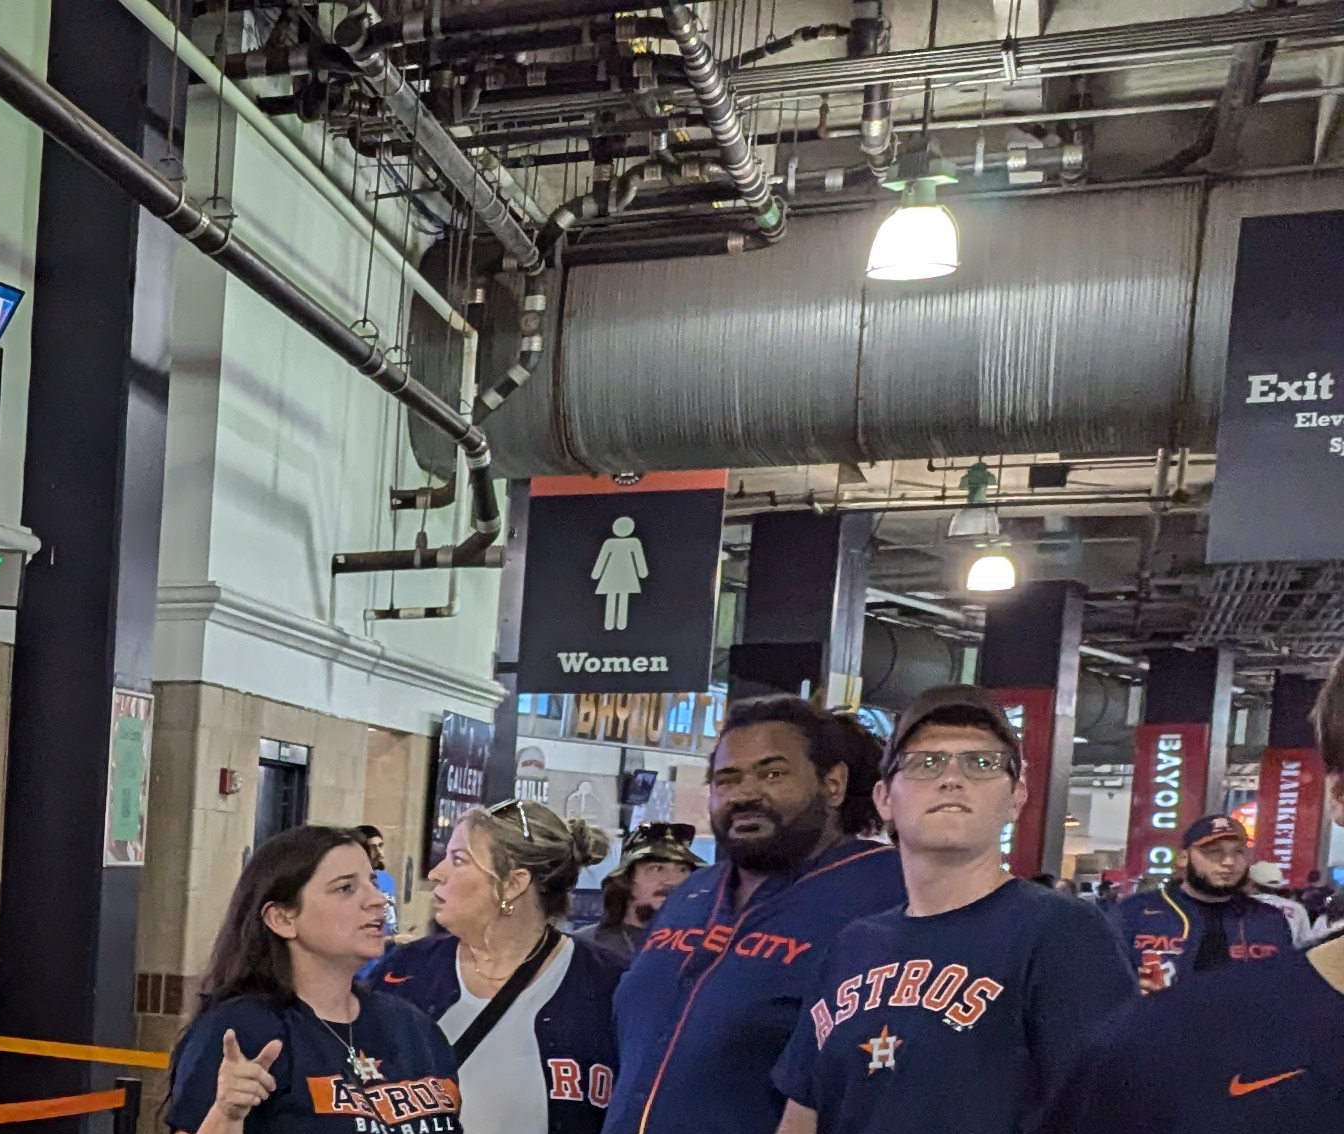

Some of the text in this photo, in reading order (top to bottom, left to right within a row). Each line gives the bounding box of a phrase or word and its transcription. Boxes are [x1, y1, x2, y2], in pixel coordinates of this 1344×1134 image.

[1245, 372, 1334, 403] Exit
[1294, 412, 1344, 428] Elev
[557, 652, 668, 673] Women
[1148, 733, 1183, 875] BAYOU CI
[1273, 760, 1302, 885] MARKETPL
[734, 931, 812, 965] CITY
[811, 958, 1003, 1050] ASTROS
[870, 1034, 897, 1070] H
